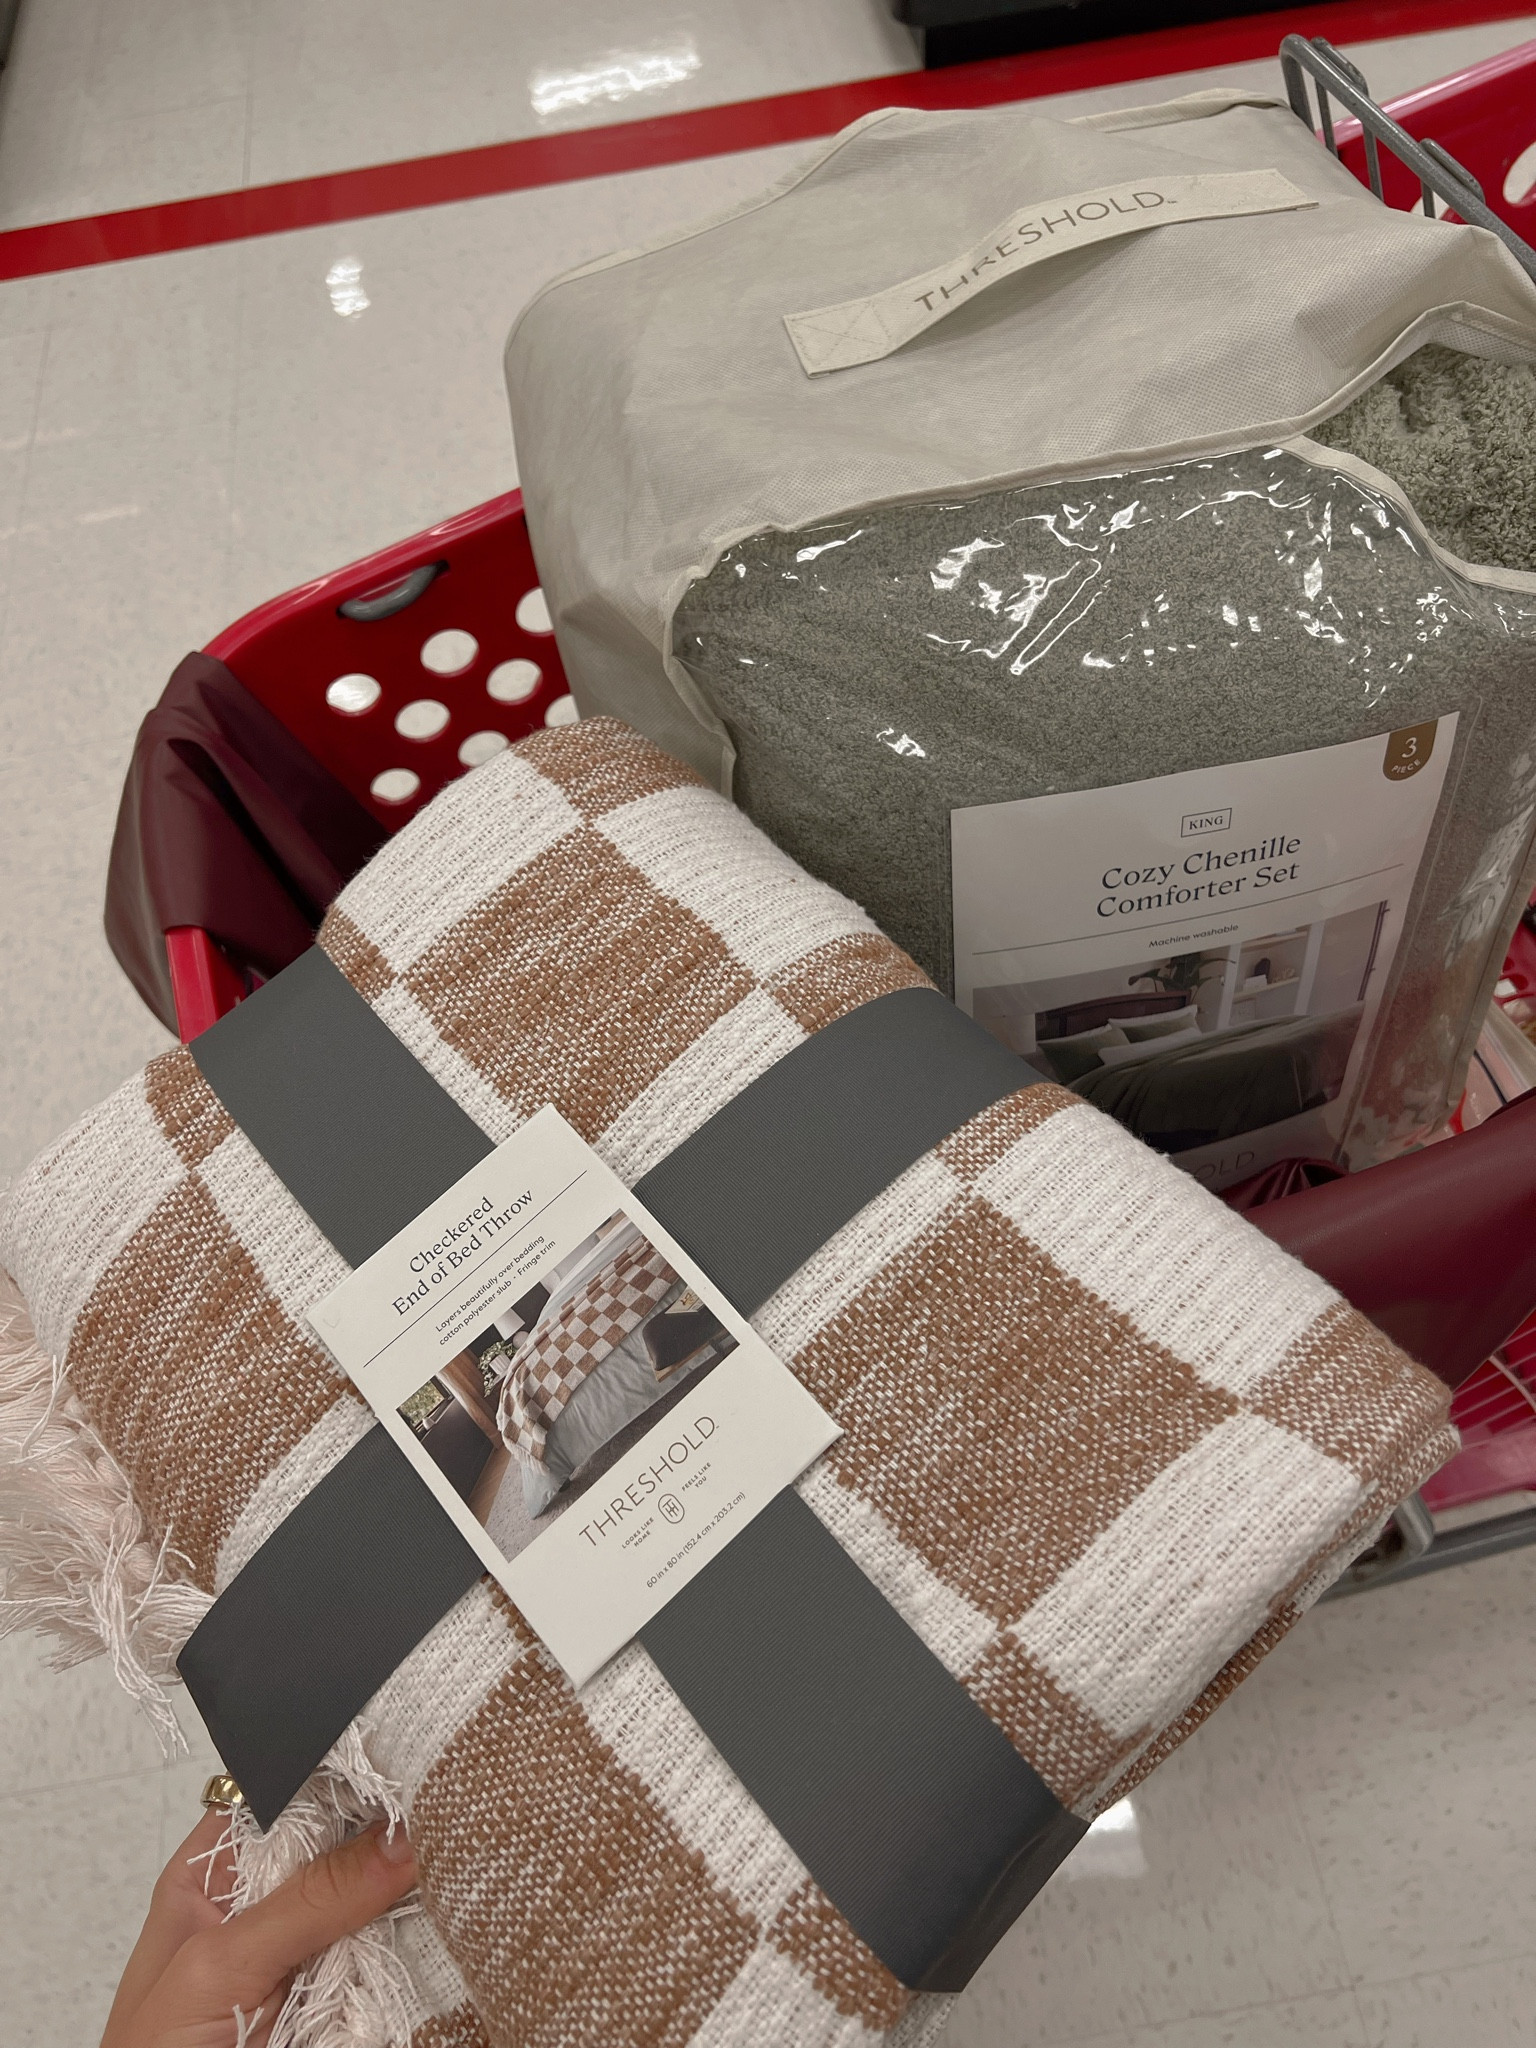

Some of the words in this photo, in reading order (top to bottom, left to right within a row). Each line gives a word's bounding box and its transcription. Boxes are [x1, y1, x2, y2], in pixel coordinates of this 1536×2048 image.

[914, 191, 1165, 311] THRESHOLD
[1402, 737, 1417, 758] 3
[1189, 815, 1223, 830] KING
[1102, 864, 1175, 888] Cozy
[1183, 835, 1300, 874] Chenille
[1097, 877, 1247, 917] Comforter
[1253, 863, 1300, 888] Set
[1149, 934, 1190, 947] Machine
[1193, 923, 1239, 939] washable
[392, 1279, 430, 1316] End
[430, 1262, 449, 1284] of
[446, 1234, 483, 1269] Bed
[479, 1190, 533, 1238] Throw
[409, 1196, 494, 1273] Checkered
[435, 1309, 462, 1332] Layers
[459, 1276, 498, 1311] beautifully
[498, 1261, 514, 1278] over
[513, 1235, 545, 1263] bedding
[439, 1322, 464, 1346] cotton
[463, 1293, 496, 1326] polyester
[497, 1280, 512, 1295] slub
[517, 1254, 541, 1276] Fringe
[540, 1240, 556, 1255] trim
[579, 1416, 715, 1546] THRESHOLD
[682, 1474, 698, 1491] FEELS
[698, 1462, 711, 1475] LIKE
[695, 1476, 707, 1488] YOU
[622, 1529, 641, 1549] LOOKS
[640, 1517, 654, 1531] LIKE
[634, 1530, 650, 1547] HOME
[646, 1576, 658, 1588] 60
[656, 1571, 665, 1579] in
[666, 1556, 678, 1568] 80
[677, 1551, 685, 1559] in
[683, 1533, 702, 1554] (152.4
[701, 1524, 712, 1536] cm
[714, 1502, 734, 1523] 203.2
[732, 1491, 746, 1505] cm)
